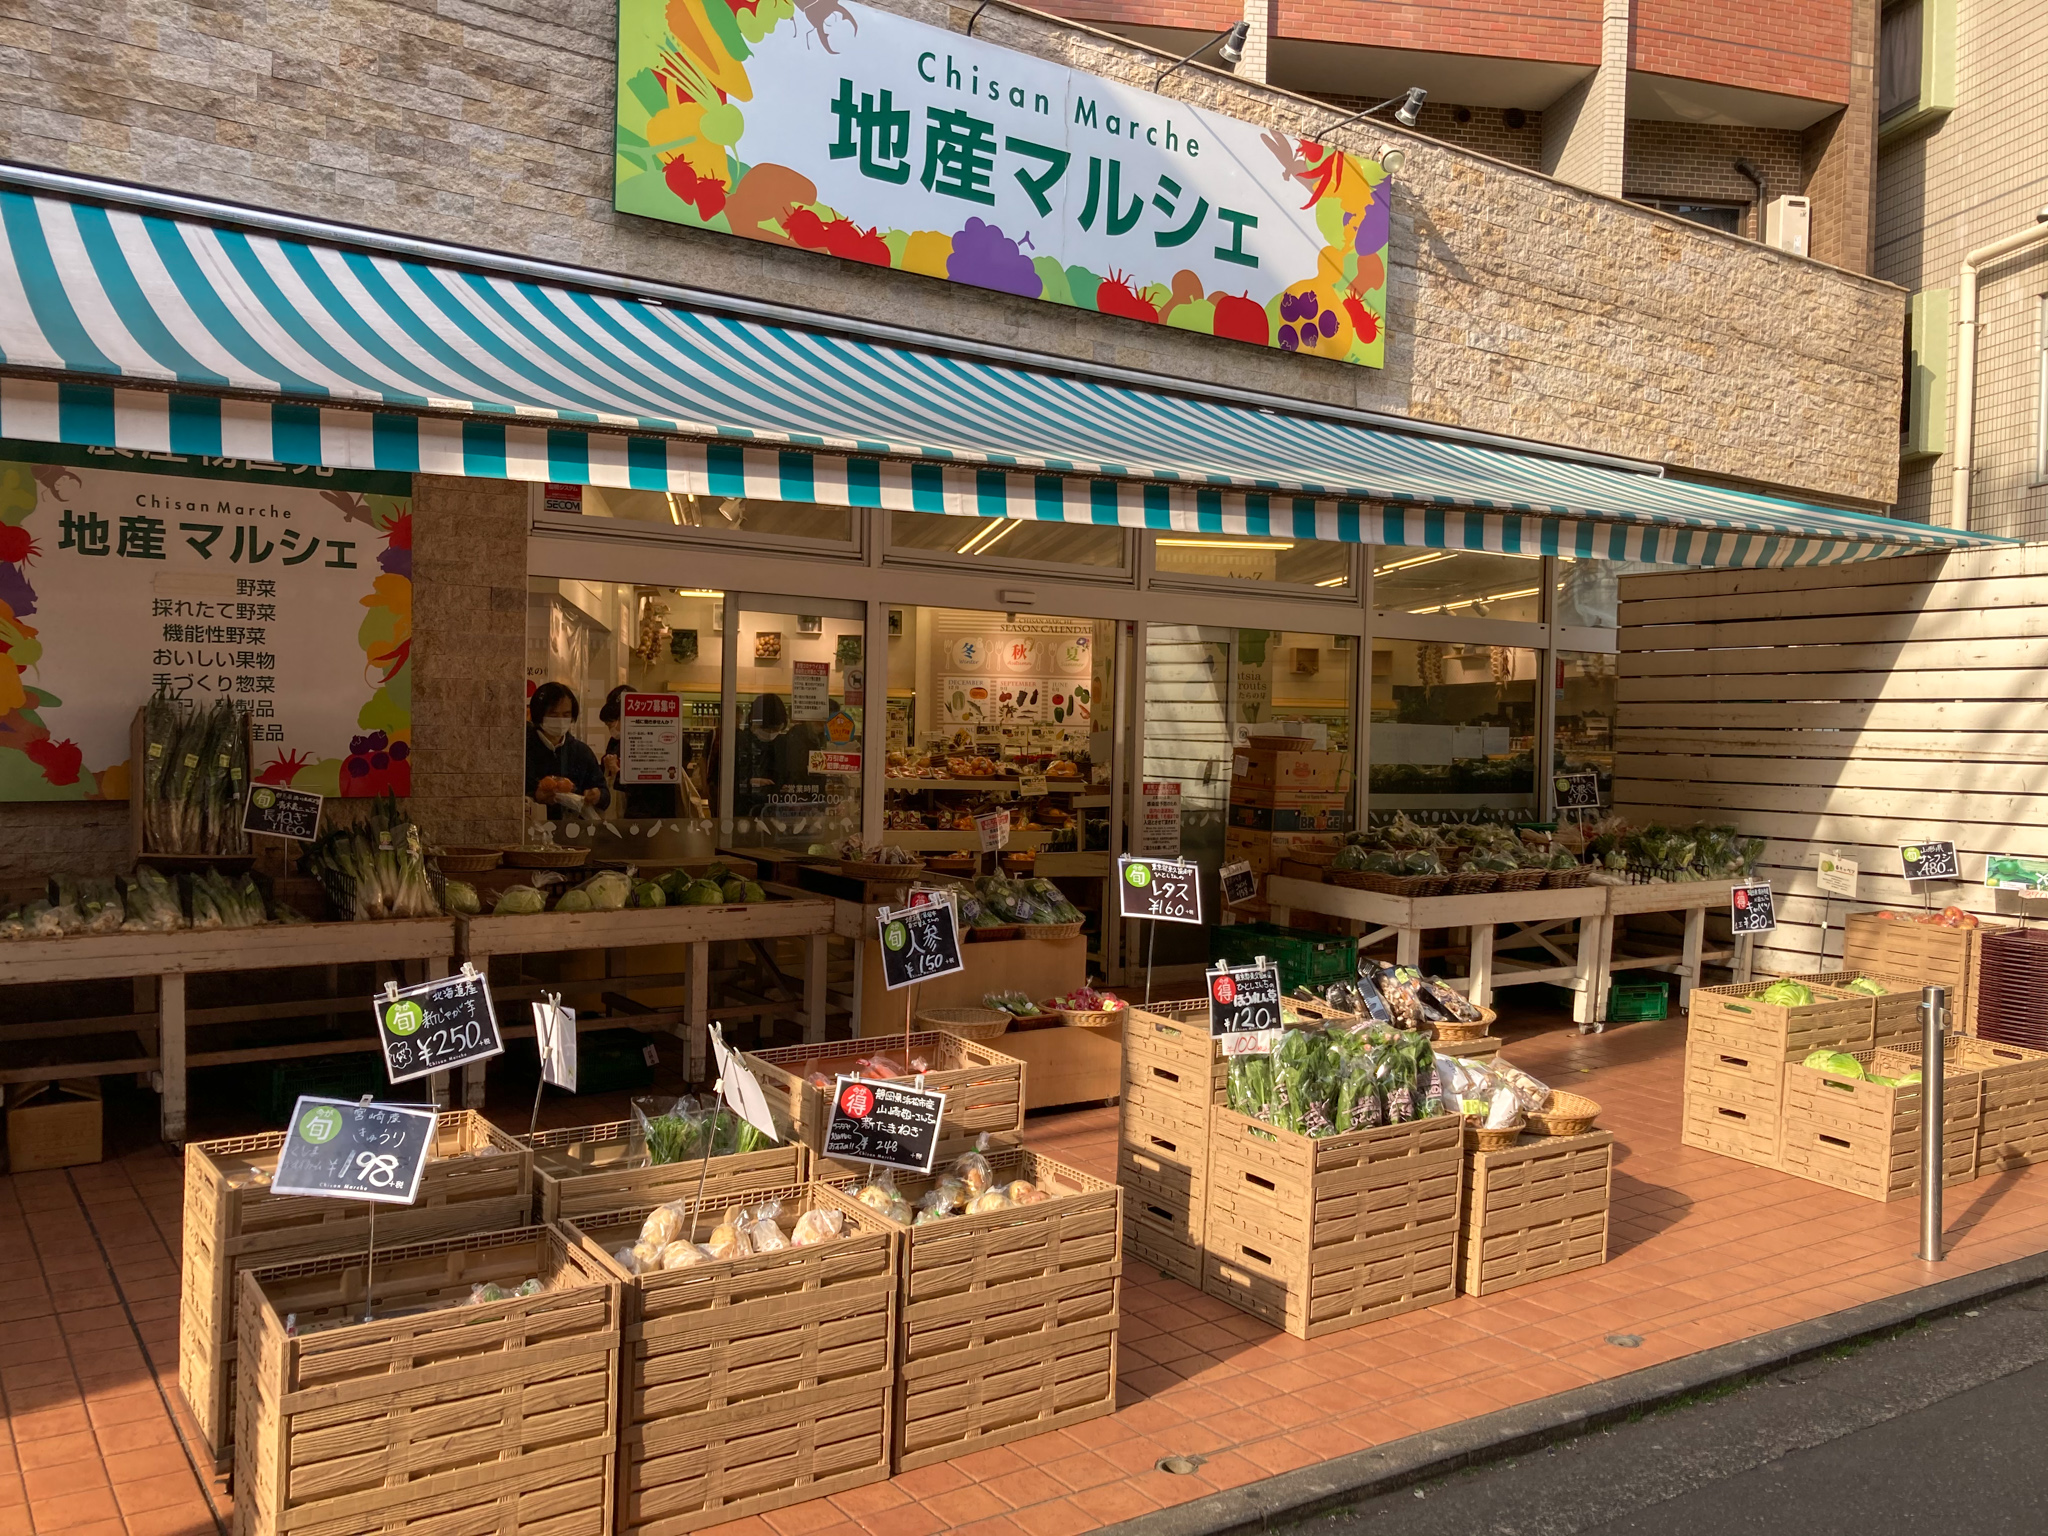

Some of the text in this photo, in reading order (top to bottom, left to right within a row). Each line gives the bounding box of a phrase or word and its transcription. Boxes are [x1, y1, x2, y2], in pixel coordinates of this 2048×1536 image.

[917, 51, 1200, 158] Chisan Marche
[828, 77, 1259, 269] 地産マルシェ
[136, 494, 292, 519] Chisan Marche
[546, 499, 581, 511] SECOM
[58, 510, 357, 570] 地産マルシェ
[236, 578, 276, 597] 野菜
[152, 598, 276, 622] 採れたて野菜
[163, 624, 265, 645] 機能性野菜
[1000, 624, 1039, 633] SEASON
[153, 649, 275, 670] おいしい果物
[961, 642, 976, 659] 冬
[1012, 643, 1028, 660] 秋
[1066, 646, 1079, 661] 夏
[627, 699, 676, 713] スタッフ募集中
[787, 784, 819, 793] 営業時間
[257, 794, 271, 807] 旬
[262, 809, 309, 825] 長ねぎ
[1918, 851, 1953, 865] サンフジ
[1129, 869, 1146, 886] 旬
[1151, 879, 1189, 902] レタス
[1147, 897, 1184, 917] ¥160
[888, 930, 902, 948] 旬
[905, 923, 943, 958] 人参
[432, 980, 479, 1002] 北海道産
[1217, 983, 1233, 1002] 得
[1233, 988, 1278, 1008] ほうれん草
[392, 1010, 416, 1032] 旬
[1223, 1007, 1270, 1033] ¥120
[416, 1020, 481, 1067] ¥250
[846, 1093, 867, 1116] 得
[875, 1087, 936, 1111] 静岡県浜松市産
[316, 1108, 334, 1118] 今が
[353, 1108, 402, 1124] 宮崎産
[306, 1116, 334, 1140] 旬
[861, 1114, 924, 1138] 新たまねぎ
[352, 1128, 406, 1149] きゅうり
[328, 1150, 400, 1188] ¥198
[319, 1181, 342, 1189] Chisan
